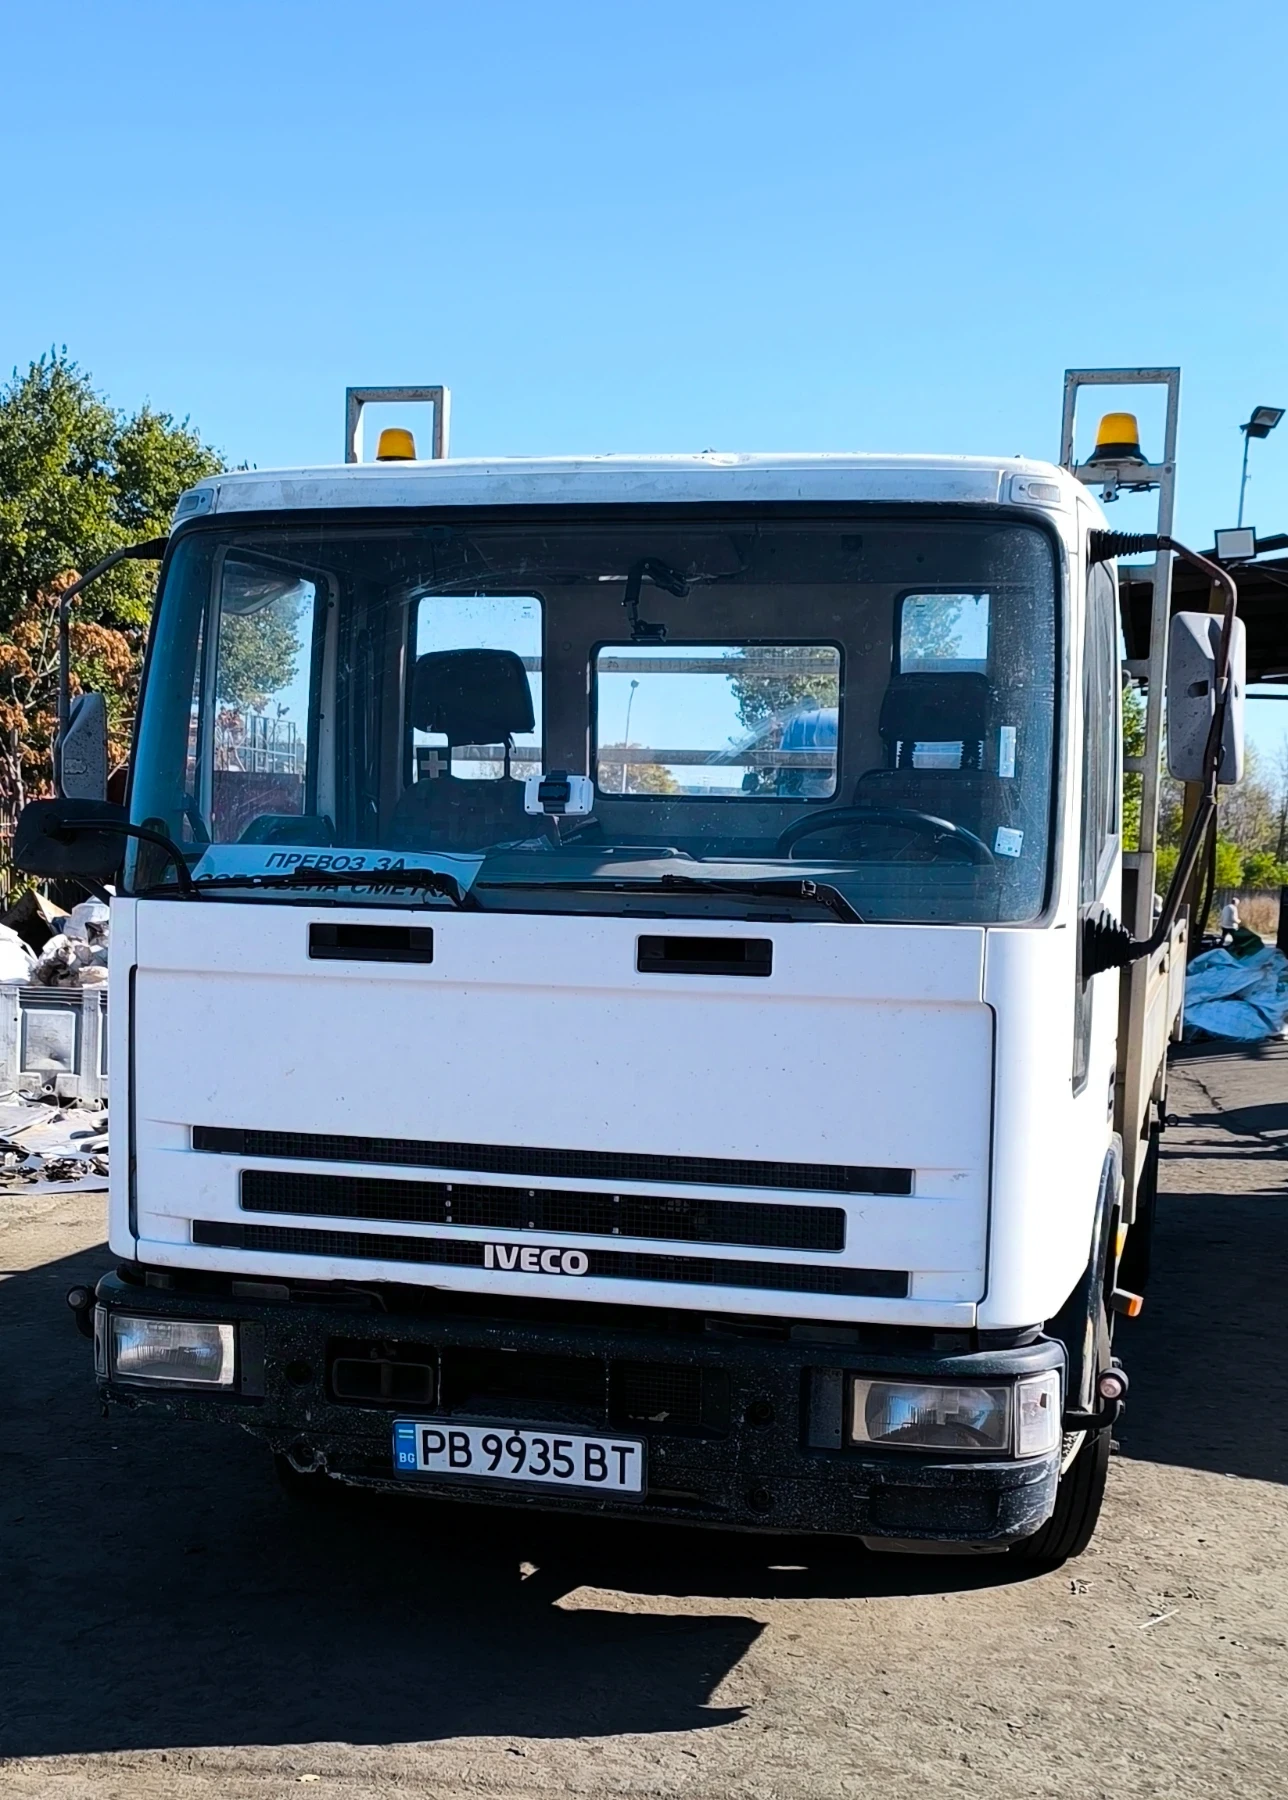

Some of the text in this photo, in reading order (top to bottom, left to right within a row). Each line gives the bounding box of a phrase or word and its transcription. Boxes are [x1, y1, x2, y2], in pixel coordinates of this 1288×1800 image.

[264, 852, 406, 871] ПРЕВОЗ ЗА
[484, 1244, 589, 1275] IVECO
[399, 1452, 416, 1464] BG
[421, 1430, 635, 1484] PB 9935 BT
